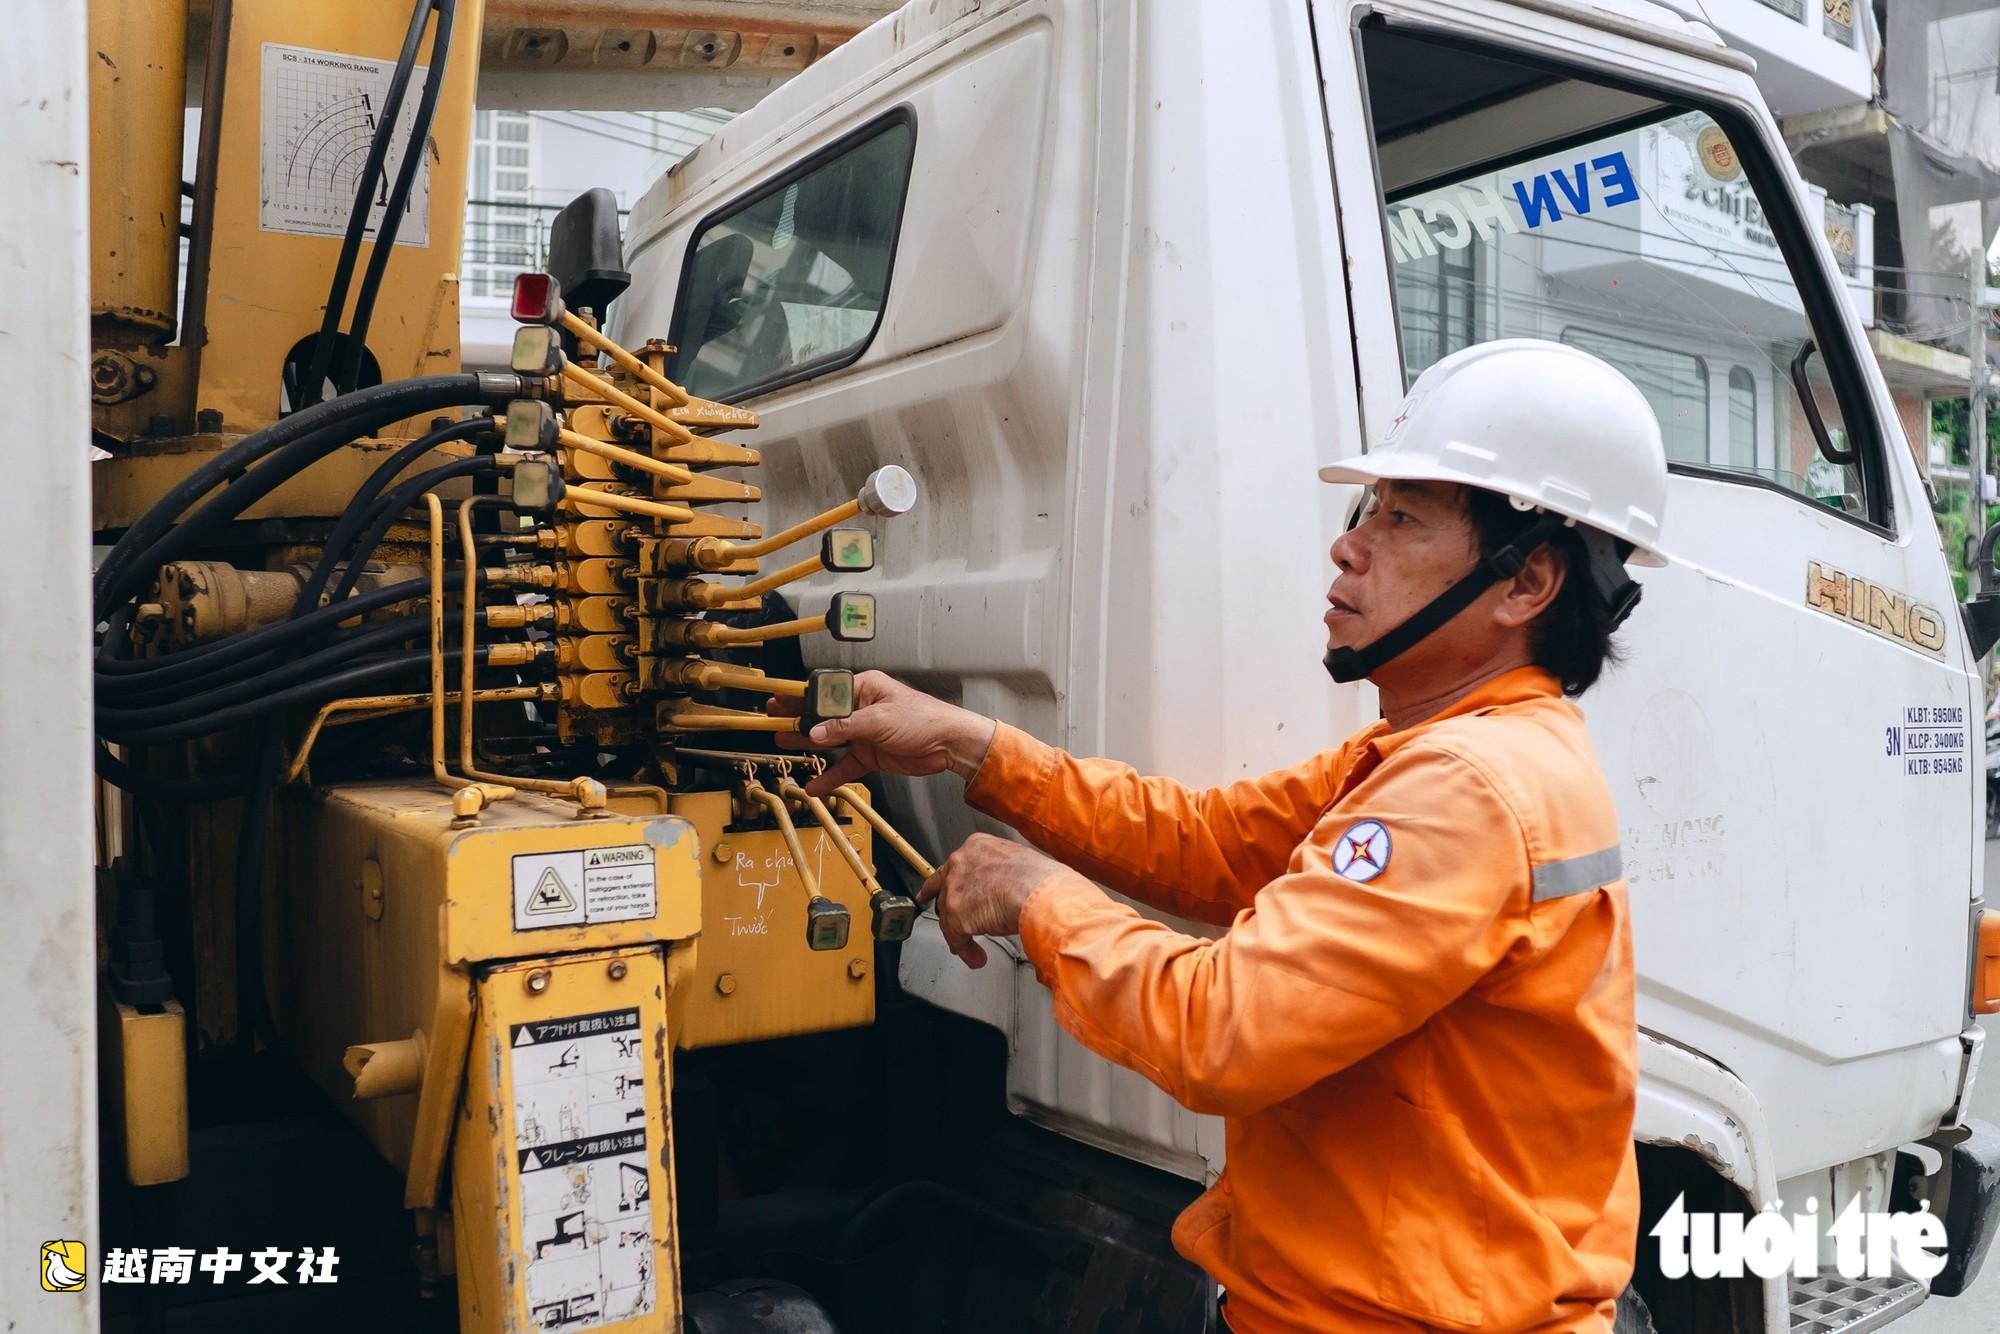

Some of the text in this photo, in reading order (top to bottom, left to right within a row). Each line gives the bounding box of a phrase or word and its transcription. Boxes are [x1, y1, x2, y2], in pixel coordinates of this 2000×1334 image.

[282, 53, 298, 62] SCS
[304, 56, 316, 64] 314
[317, 58, 353, 70] WORKING
[354, 64, 380, 74] RANGE
[1807, 560, 1945, 652] HINO
[1908, 707, 1962, 723] KLBT: 5950KG
[1886, 726, 1900, 756] 3N
[1908, 732, 1964, 749] KLCP: 3400KG
[1908, 758, 1962, 775] KLTB: 9545KG
[602, 850, 644, 863] WARNING
[736, 852, 754, 871] Ra
[588, 885, 621, 893] outriggers
[614, 904, 629, 912] your
